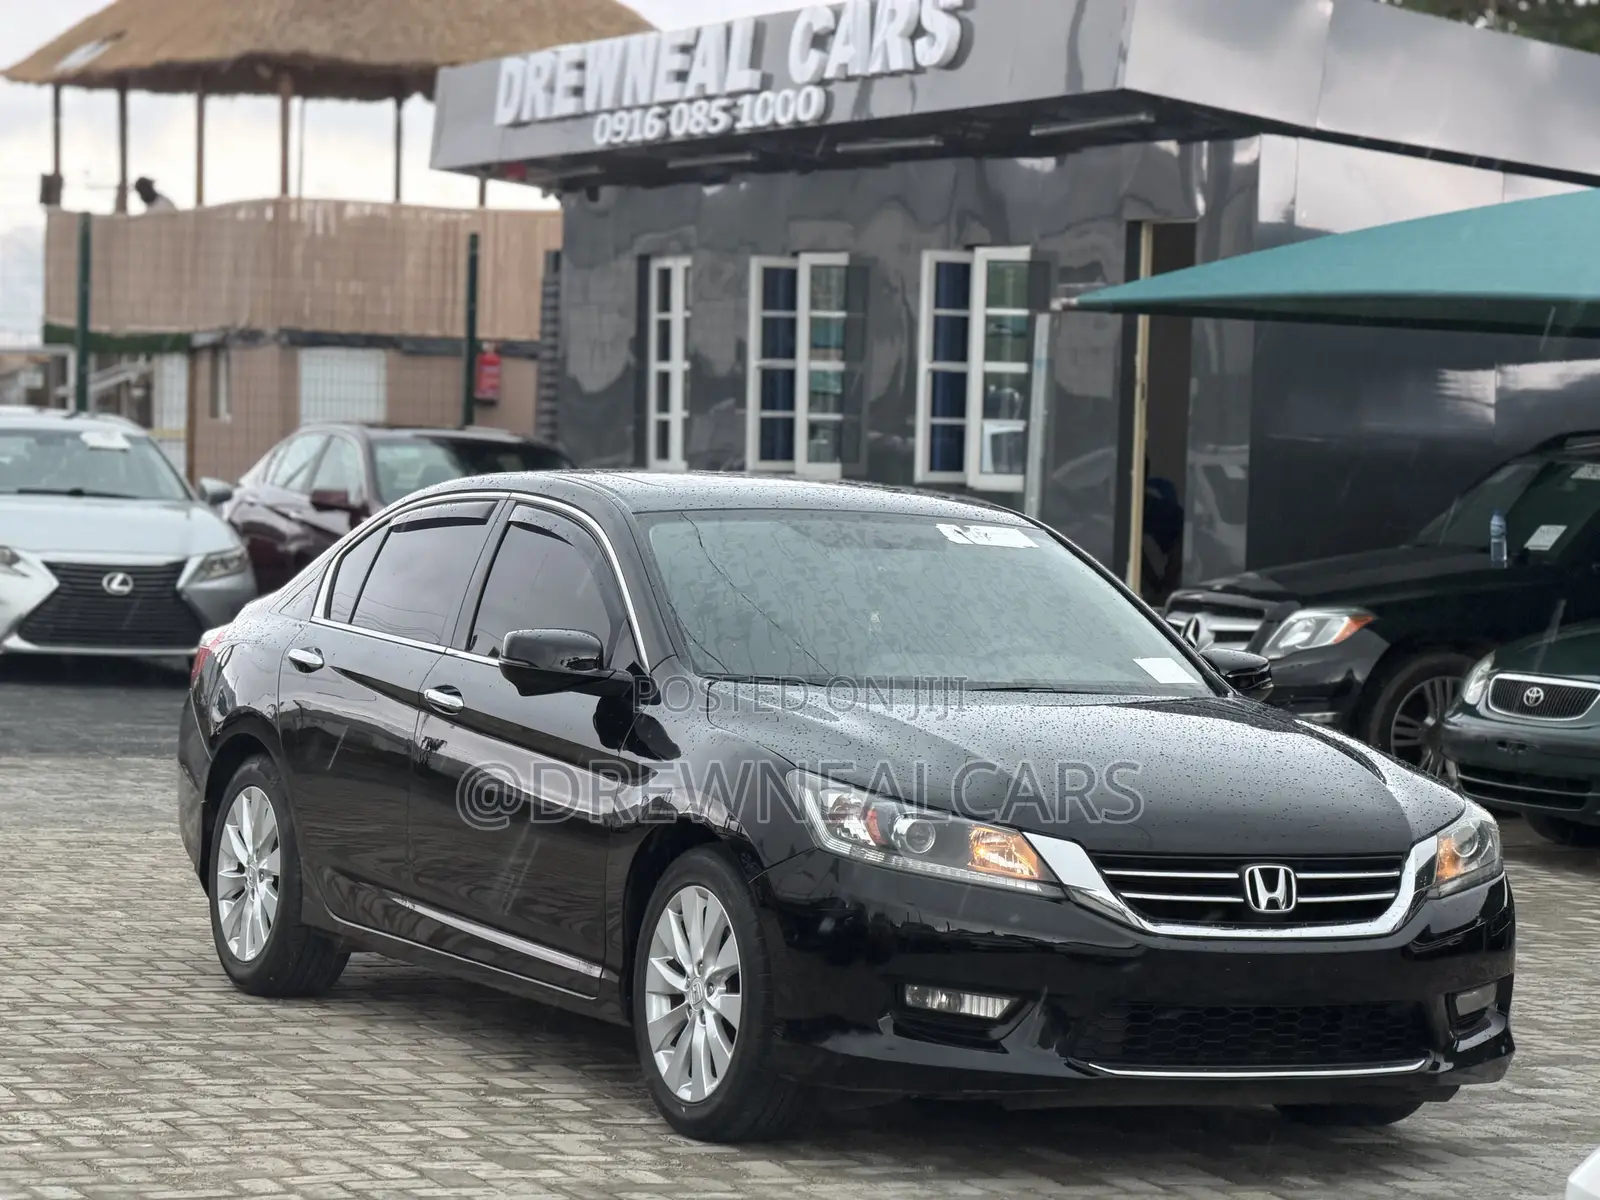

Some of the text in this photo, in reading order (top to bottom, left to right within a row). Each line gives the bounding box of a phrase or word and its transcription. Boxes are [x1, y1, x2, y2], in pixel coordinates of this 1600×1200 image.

[495, 0, 966, 125] DREWNEAL CARS
[593, 86, 822, 146] 0916 085 1000
